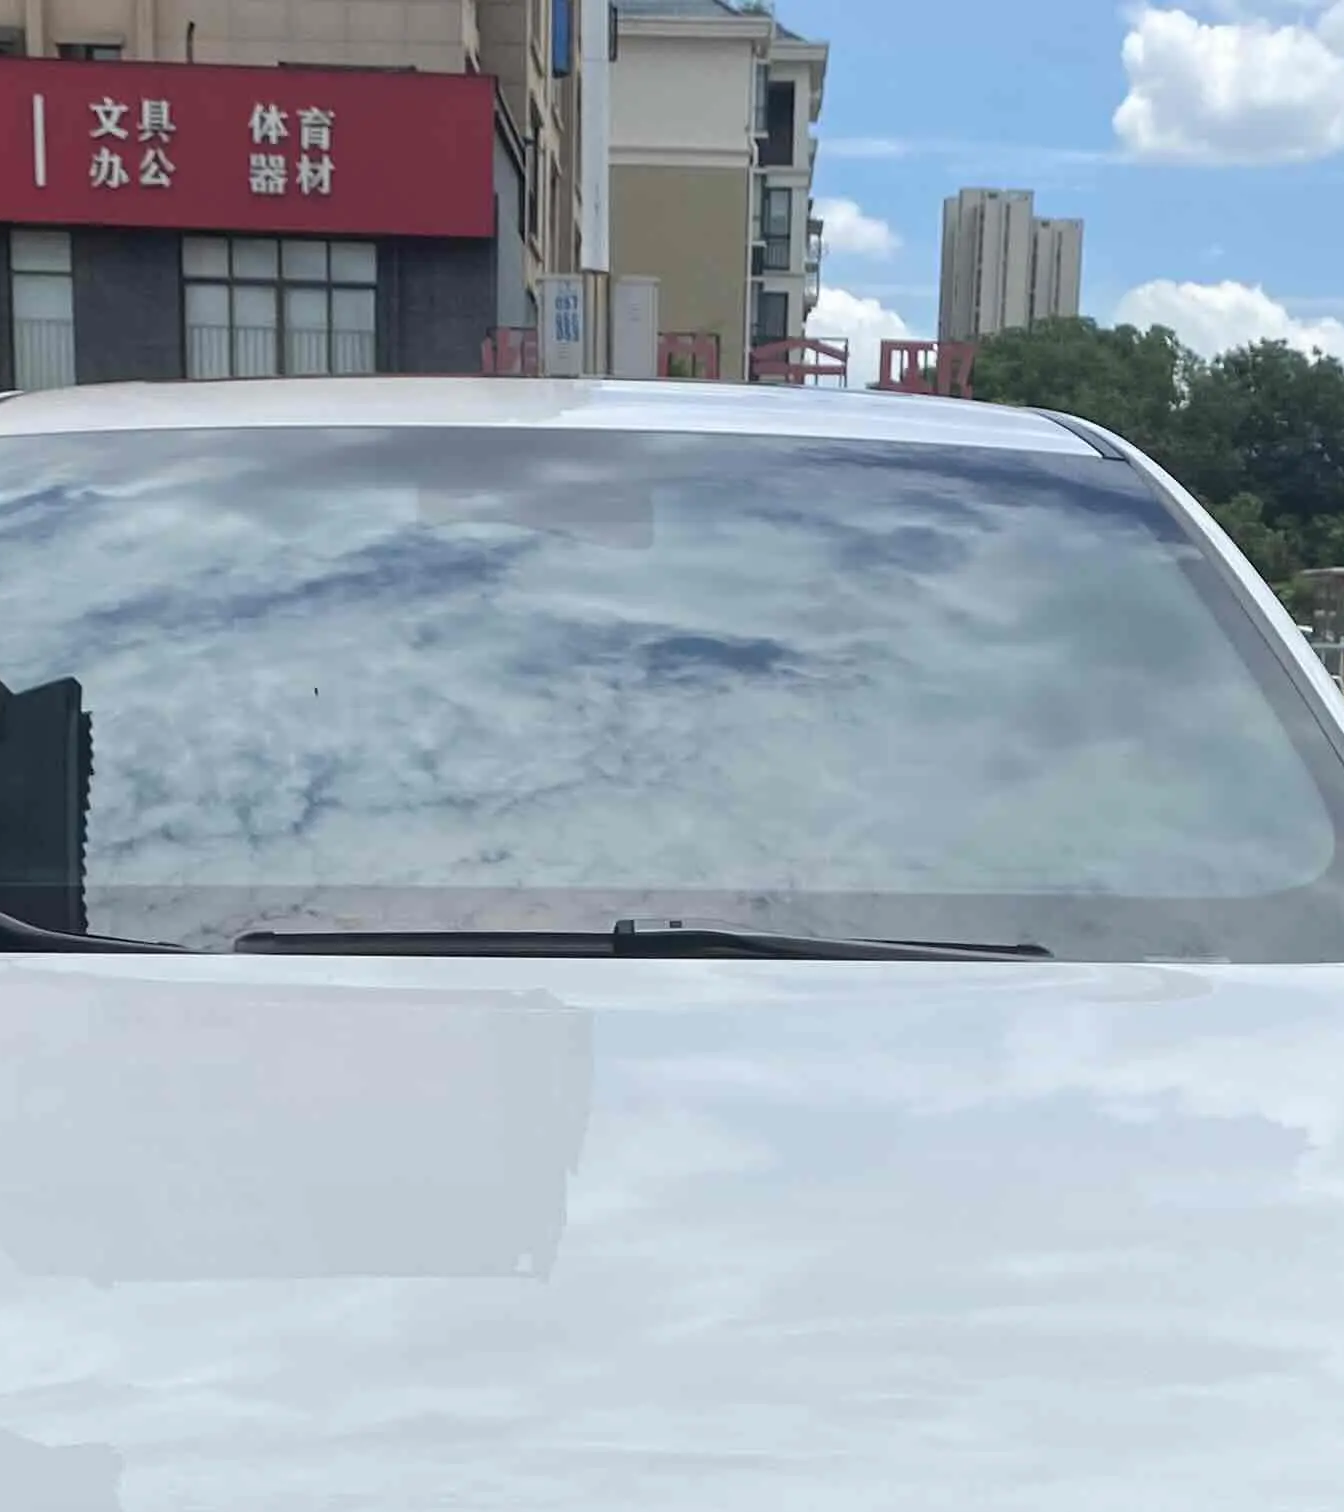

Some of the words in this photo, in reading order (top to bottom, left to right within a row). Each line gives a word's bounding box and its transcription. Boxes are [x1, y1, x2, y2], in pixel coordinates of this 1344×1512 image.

[88, 96, 177, 143] 文具
[247, 102, 336, 151] 体育
[88, 146, 176, 189] 办公
[248, 152, 336, 195] 器材
